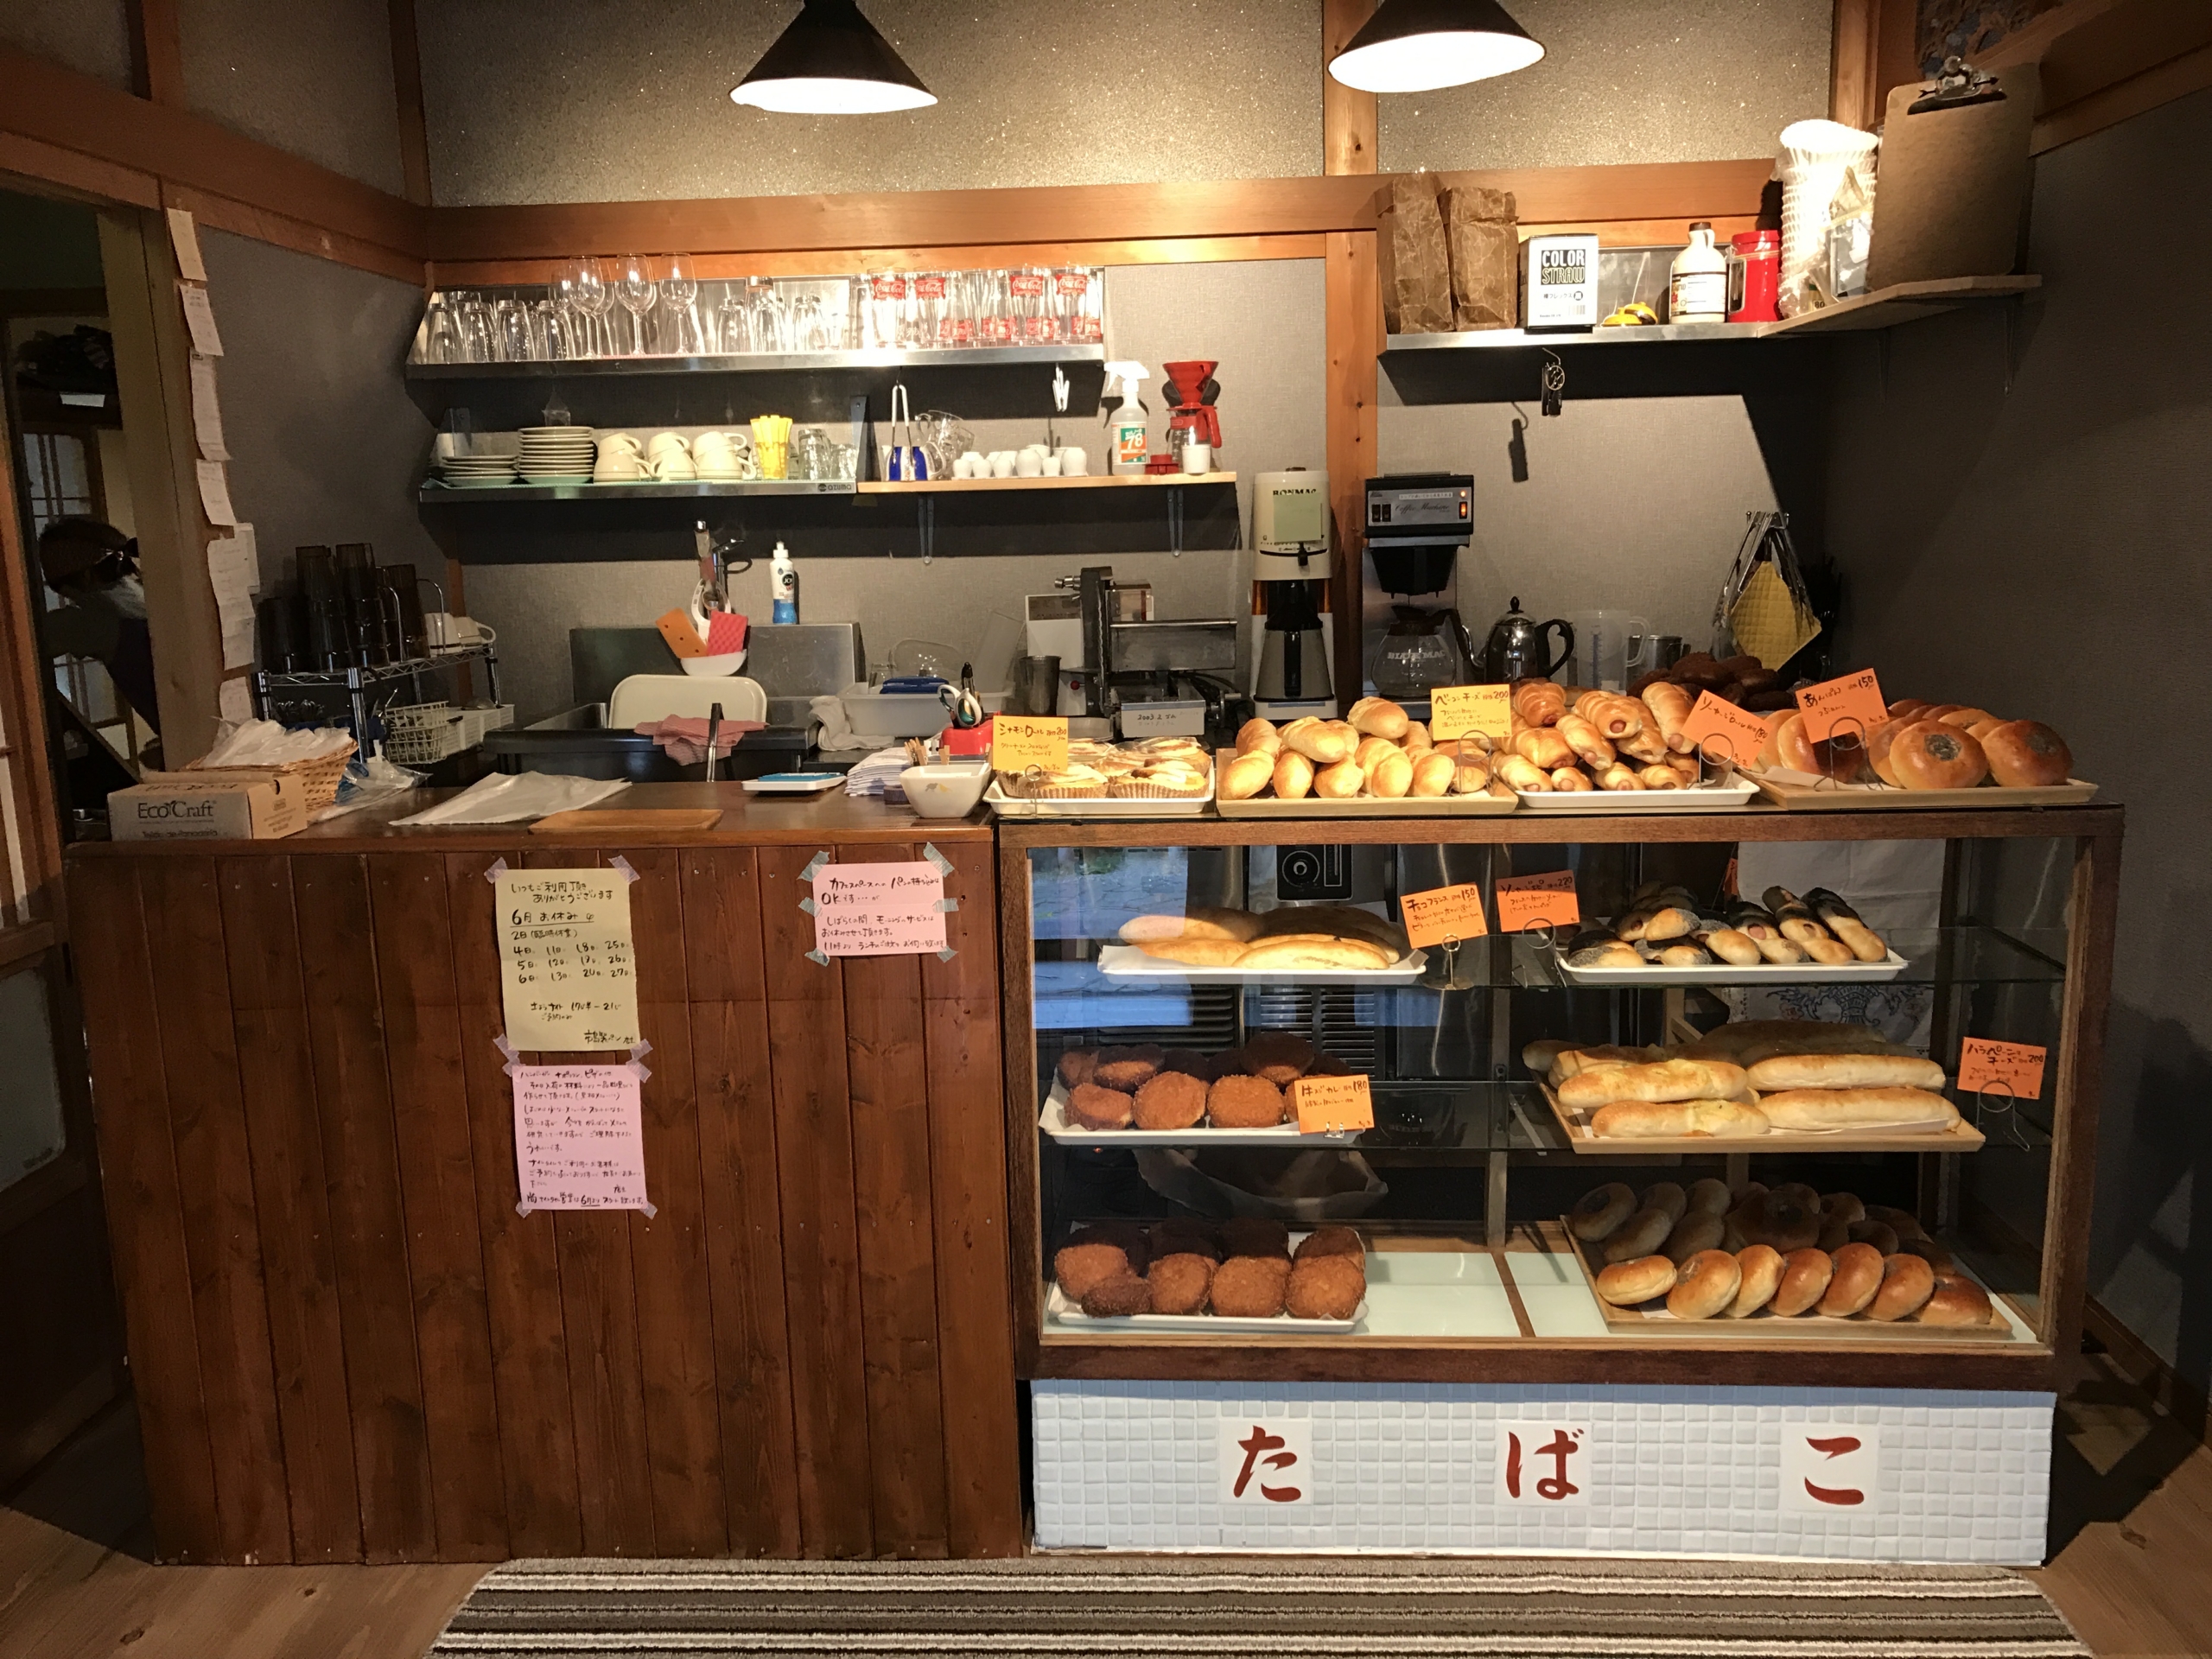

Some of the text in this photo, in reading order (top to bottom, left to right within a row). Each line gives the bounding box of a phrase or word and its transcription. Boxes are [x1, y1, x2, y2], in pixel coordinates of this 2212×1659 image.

[1541, 250, 1586, 268] COLOR
[1541, 267, 1586, 284] STRAW
[1125, 432, 1143, 449] 78
[1858, 674, 1874, 690] 150
[1493, 690, 1509, 700] 200
[138, 800, 213, 819] EcoCraft
[511, 880, 588, 893] いつもご利用頂き
[532, 888, 613, 904] ありがとうございます
